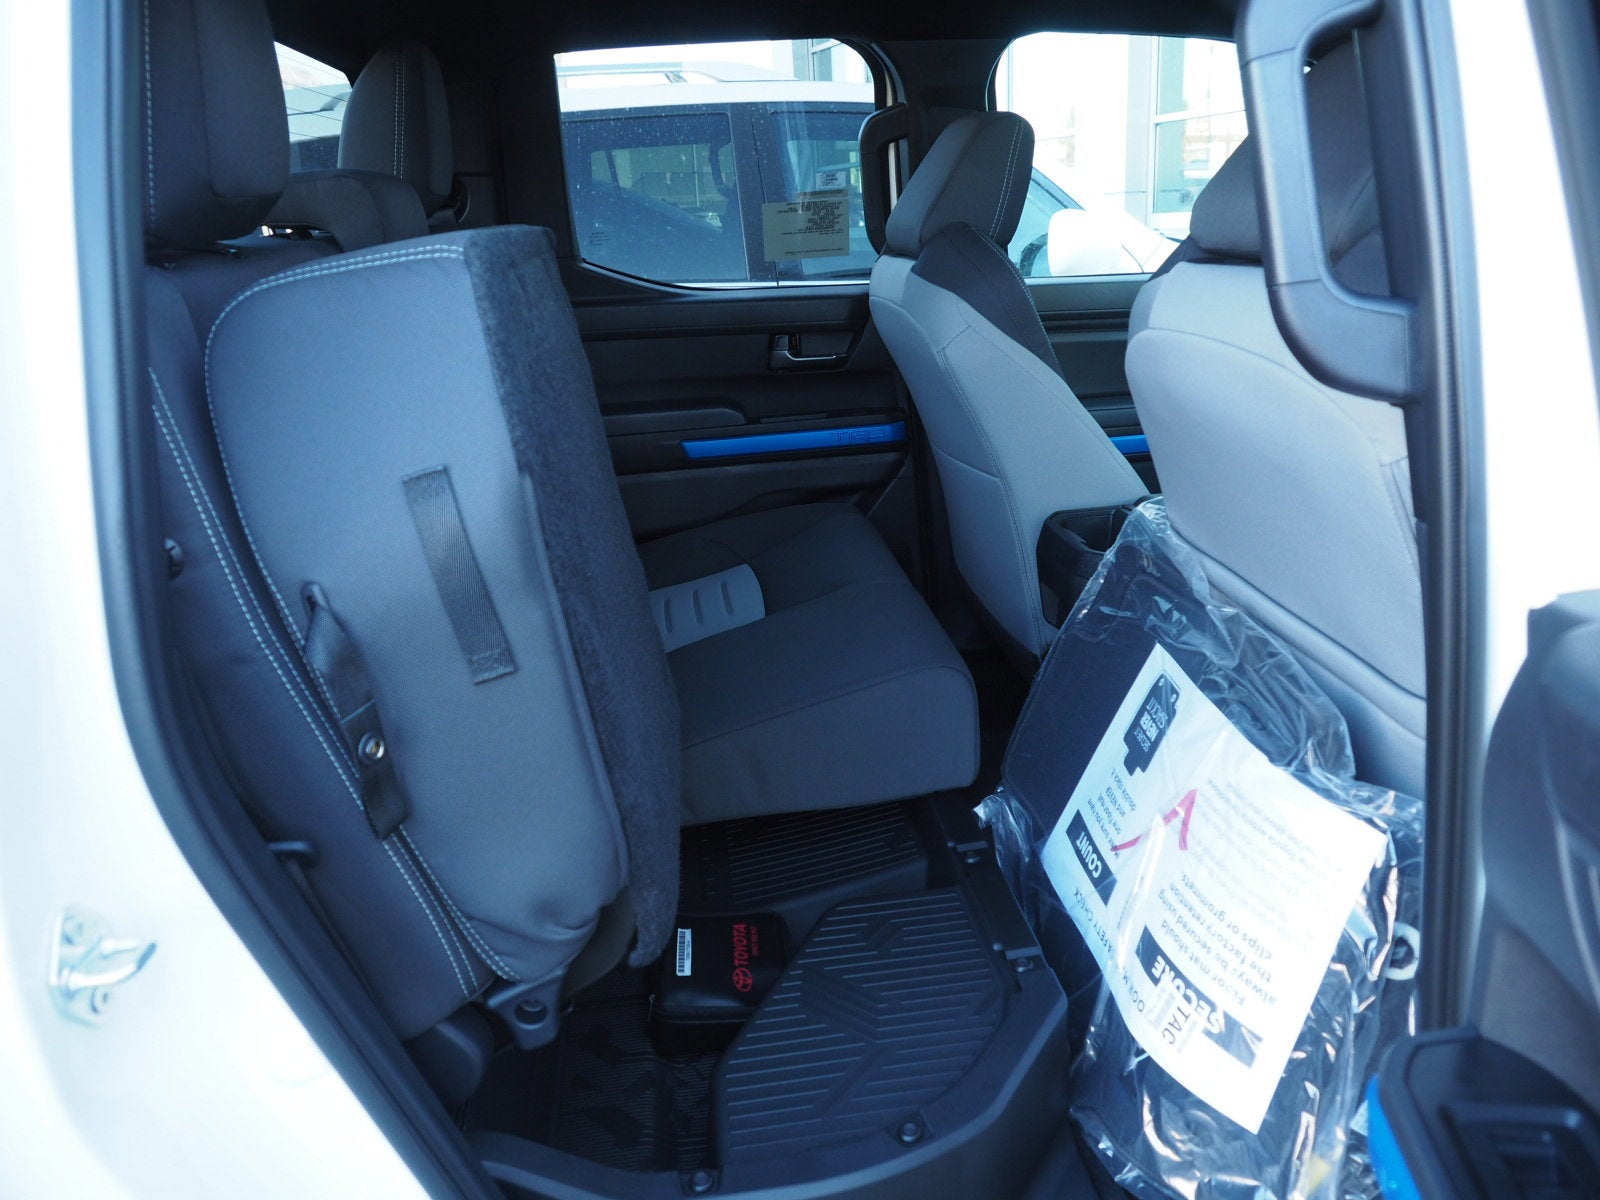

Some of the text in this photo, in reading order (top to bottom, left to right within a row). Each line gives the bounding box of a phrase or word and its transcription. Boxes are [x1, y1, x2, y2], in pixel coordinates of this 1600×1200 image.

[834, 426, 886, 445] TRD
[1138, 711, 1158, 741] NEVER
[1105, 785, 1117, 808] NEVER
[1075, 831, 1103, 877] COUNT
[1072, 886, 1094, 921] CHECK
[1156, 888, 1177, 915] using
[1159, 919, 1189, 954] should
[1167, 882, 1271, 982] the factory retention
[1174, 915, 1212, 954] secured
[1227, 921, 1239, 934] or
[733, 923, 749, 966] TOYOTA
[1240, 932, 1272, 959] clips
[1187, 952, 1210, 975] mat
[1127, 984, 1144, 1011] OOR
[1161, 1006, 1189, 1045] TAC
